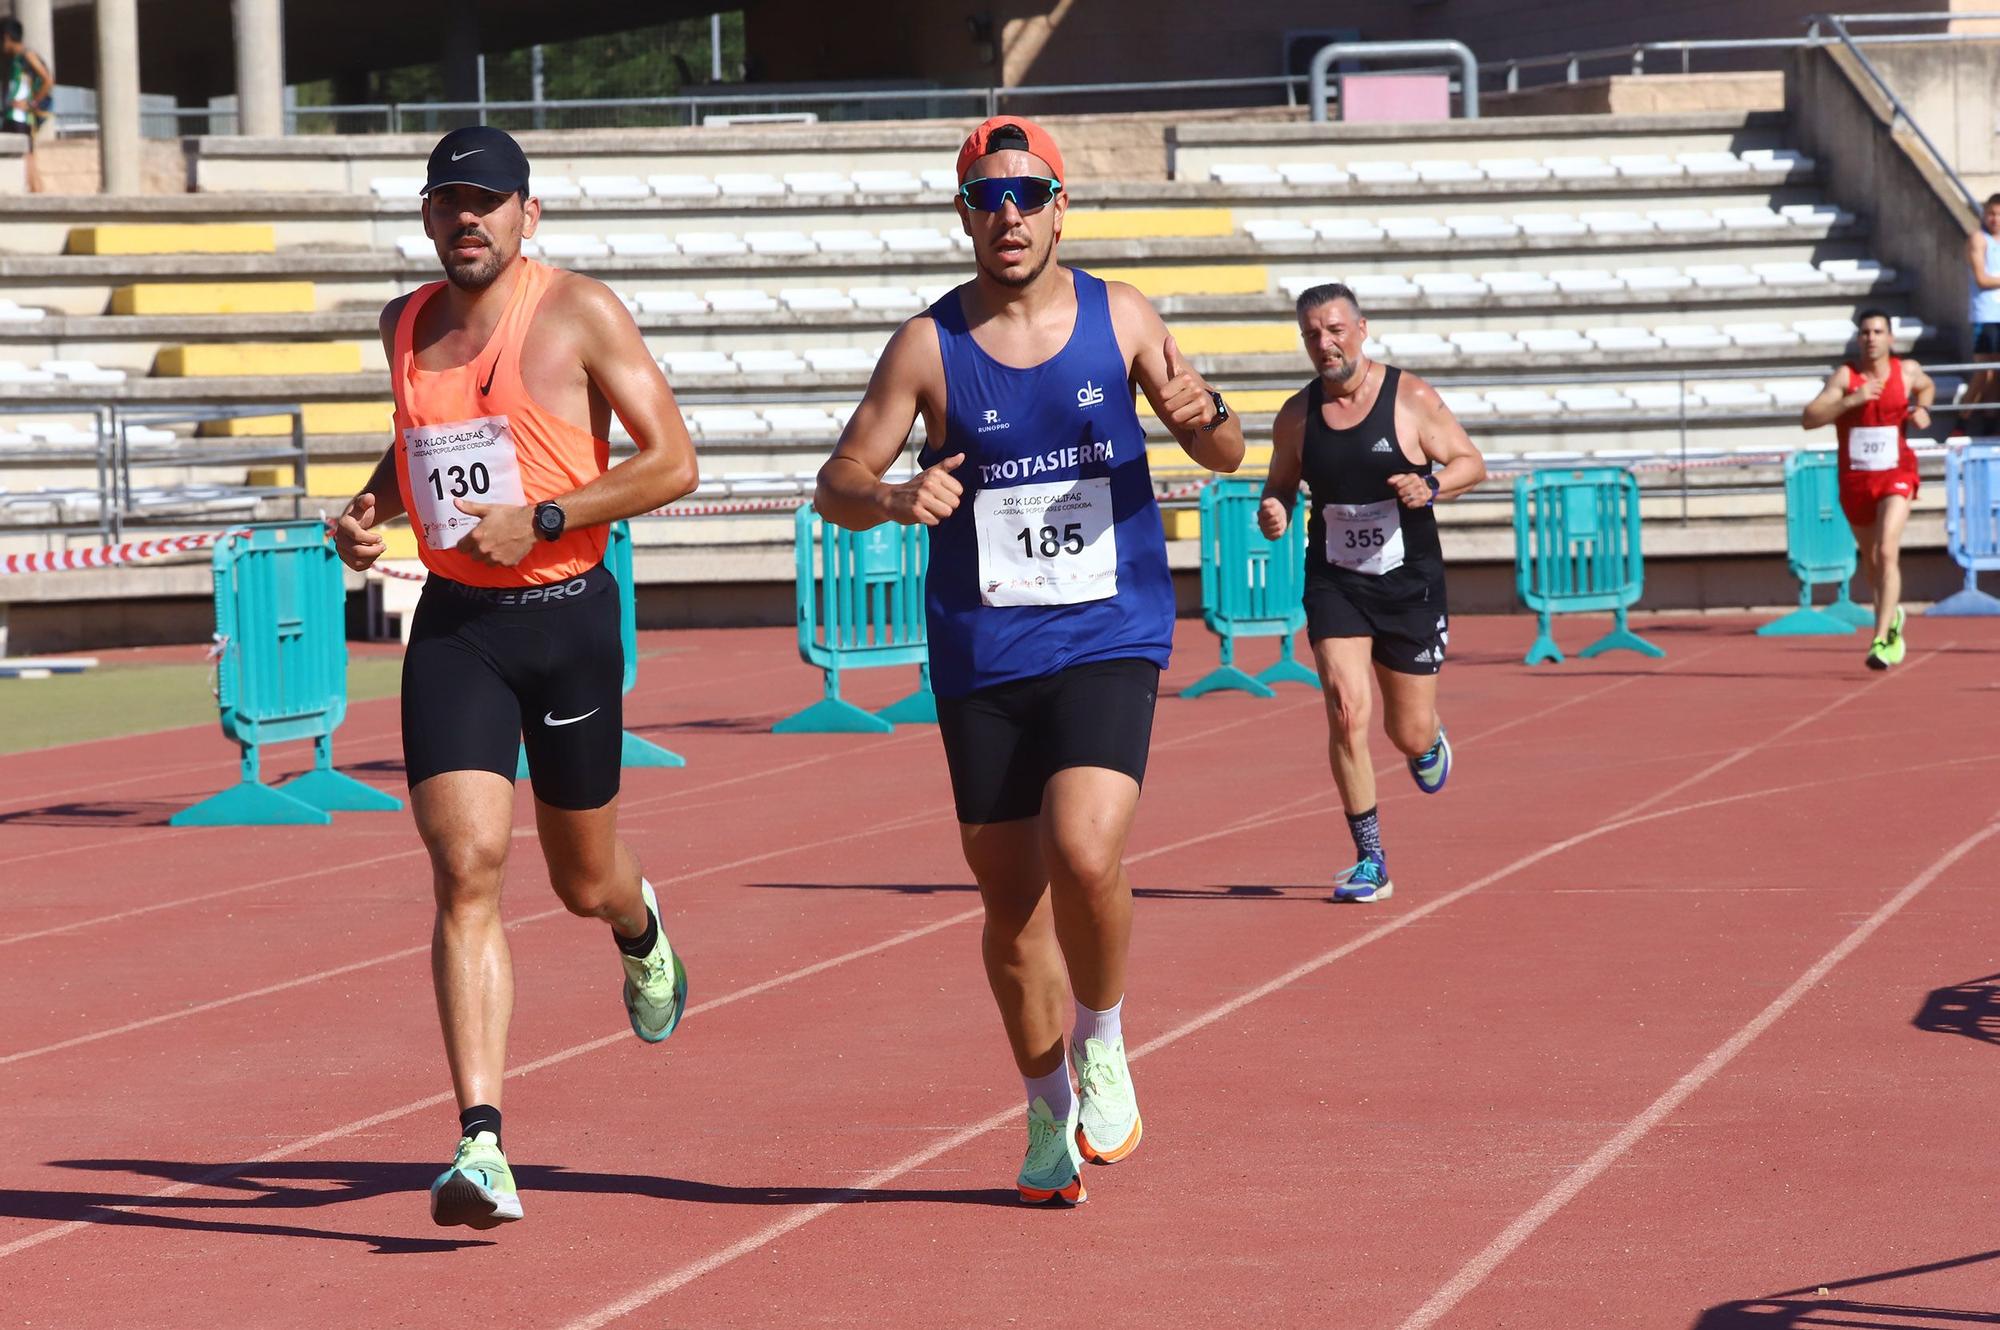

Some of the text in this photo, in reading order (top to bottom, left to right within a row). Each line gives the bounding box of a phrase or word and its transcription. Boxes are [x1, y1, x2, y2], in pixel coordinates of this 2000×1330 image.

[1077, 380, 1104, 403] als
[414, 430, 485, 448] 10 K LOS CALIFAS
[466, 440, 496, 450] CORDOBA
[1862, 442, 1886, 454] 207
[979, 440, 1114, 483] TROTASIERRA
[428, 462, 490, 501] 130
[1003, 492, 1082, 507] 10 K LOS CALIFAS
[1017, 523, 1084, 558] 185
[1345, 528, 1385, 549] 355
[519, 578, 588, 605] PRO
